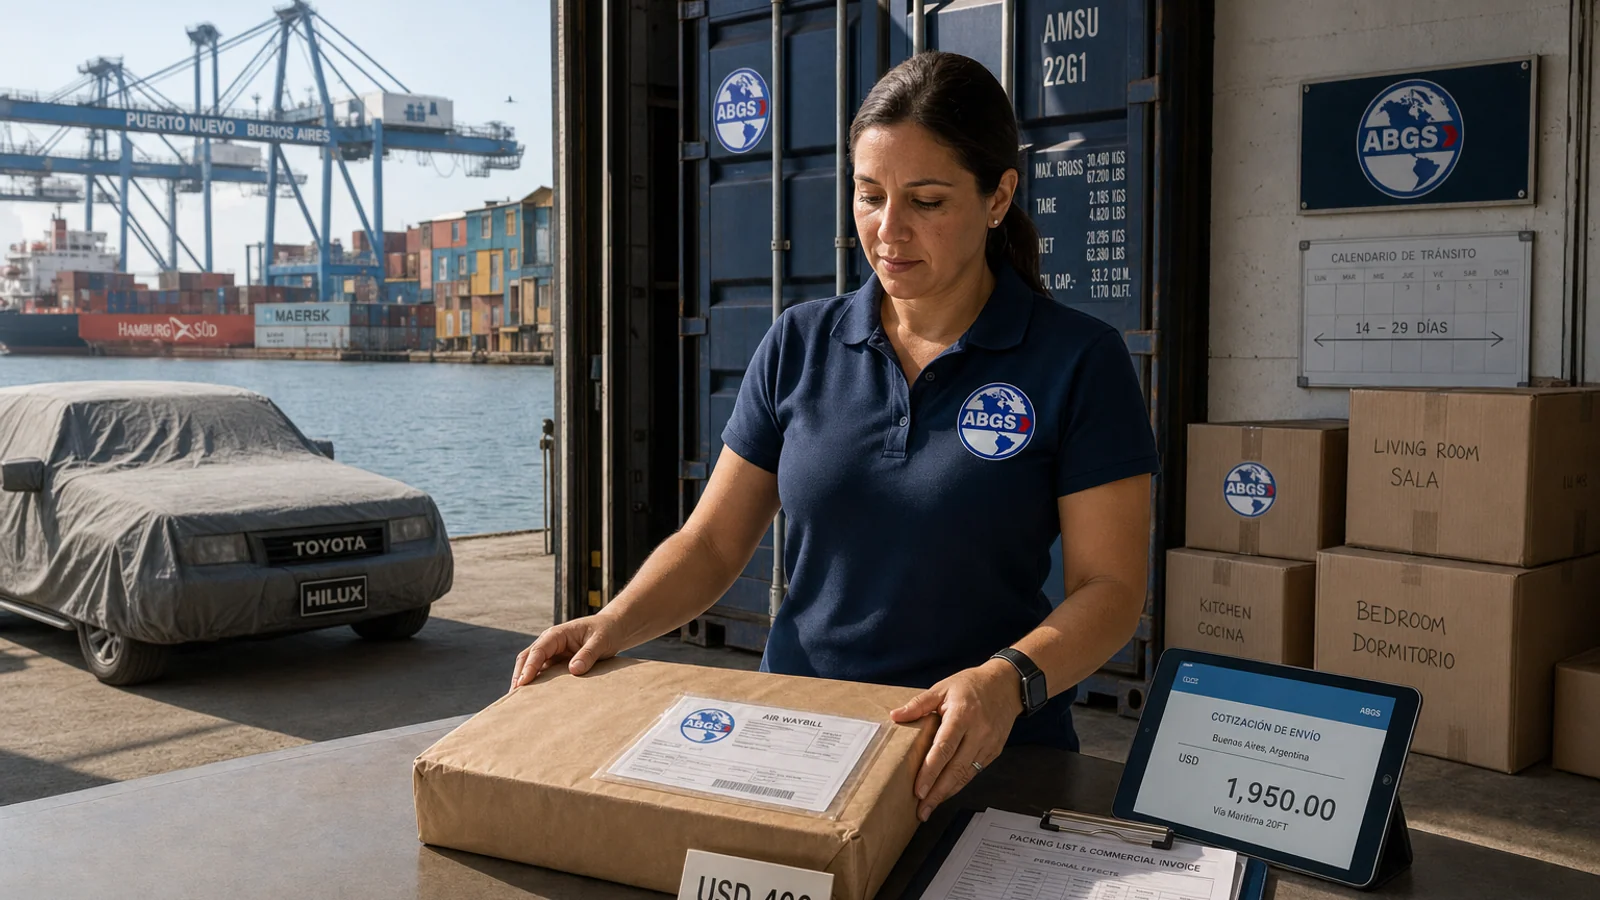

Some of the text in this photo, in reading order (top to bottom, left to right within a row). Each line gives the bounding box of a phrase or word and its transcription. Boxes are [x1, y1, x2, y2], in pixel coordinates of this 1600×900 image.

[1043, 6, 1099, 44] AMSU
[1043, 51, 1086, 87] 22G1
[717, 100, 757, 121] ABGS
[126, 112, 330, 142] PUERTO NUEVO BUENOS AIRES
[1363, 126, 1439, 153] ABGS
[1035, 162, 1054, 179] MAX.
[1057, 159, 1083, 176] GROSS
[1112, 150, 1126, 164] KGS
[1112, 167, 1125, 182] LBS
[1036, 197, 1056, 214] TARE
[1112, 188, 1126, 203] KGS
[1112, 206, 1126, 220] LBS
[1038, 237, 1054, 254] NET
[1112, 229, 1126, 243] KGS
[1112, 246, 1126, 260] LBS
[1331, 247, 1477, 264] CALENDARIO DE TRÁNSITO
[1091, 268, 1109, 282] 33.2
[1090, 284, 1109, 298] 1.170
[275, 308, 330, 322] MAERSK
[118, 322, 171, 337] HAMBURG
[1355, 322, 1370, 334] 14
[1392, 322, 1408, 334] 29
[1417, 318, 1448, 334] DÍAS
[961, 411, 1017, 430] ABGS
[1374, 439, 1480, 462] LIVING ROOM
[1225, 481, 1266, 496] ABGS
[1391, 468, 1439, 489] SALA
[293, 535, 367, 557] TOYOTA
[307, 585, 363, 607] HILUX
[1199, 598, 1252, 620] KITCHEN
[1357, 600, 1446, 635] BEDROOM
[1198, 622, 1244, 643] COCINA
[1353, 633, 1455, 670] DORMITORIO
[782, 716, 823, 728] WAYBILL
[1360, 707, 1381, 718] ABGS
[684, 719, 723, 731] ABGS
[1211, 711, 1321, 742] COTIZACIÓN DE ENVÍO
[1212, 733, 1310, 762] Buenos Aires, Argentina
[1178, 753, 1199, 766] USD
[1227, 777, 1337, 821] 1,950.00
[1265, 819, 1289, 831] 20FT
[1009, 834, 1054, 848] PACKING
[1056, 842, 1078, 852] LIST
[1089, 847, 1156, 865] COMMERCIAL
[1159, 859, 1201, 872] INVOICE
[1033, 857, 1078, 870] PERSONAL
[697, 876, 751, 900] USD
